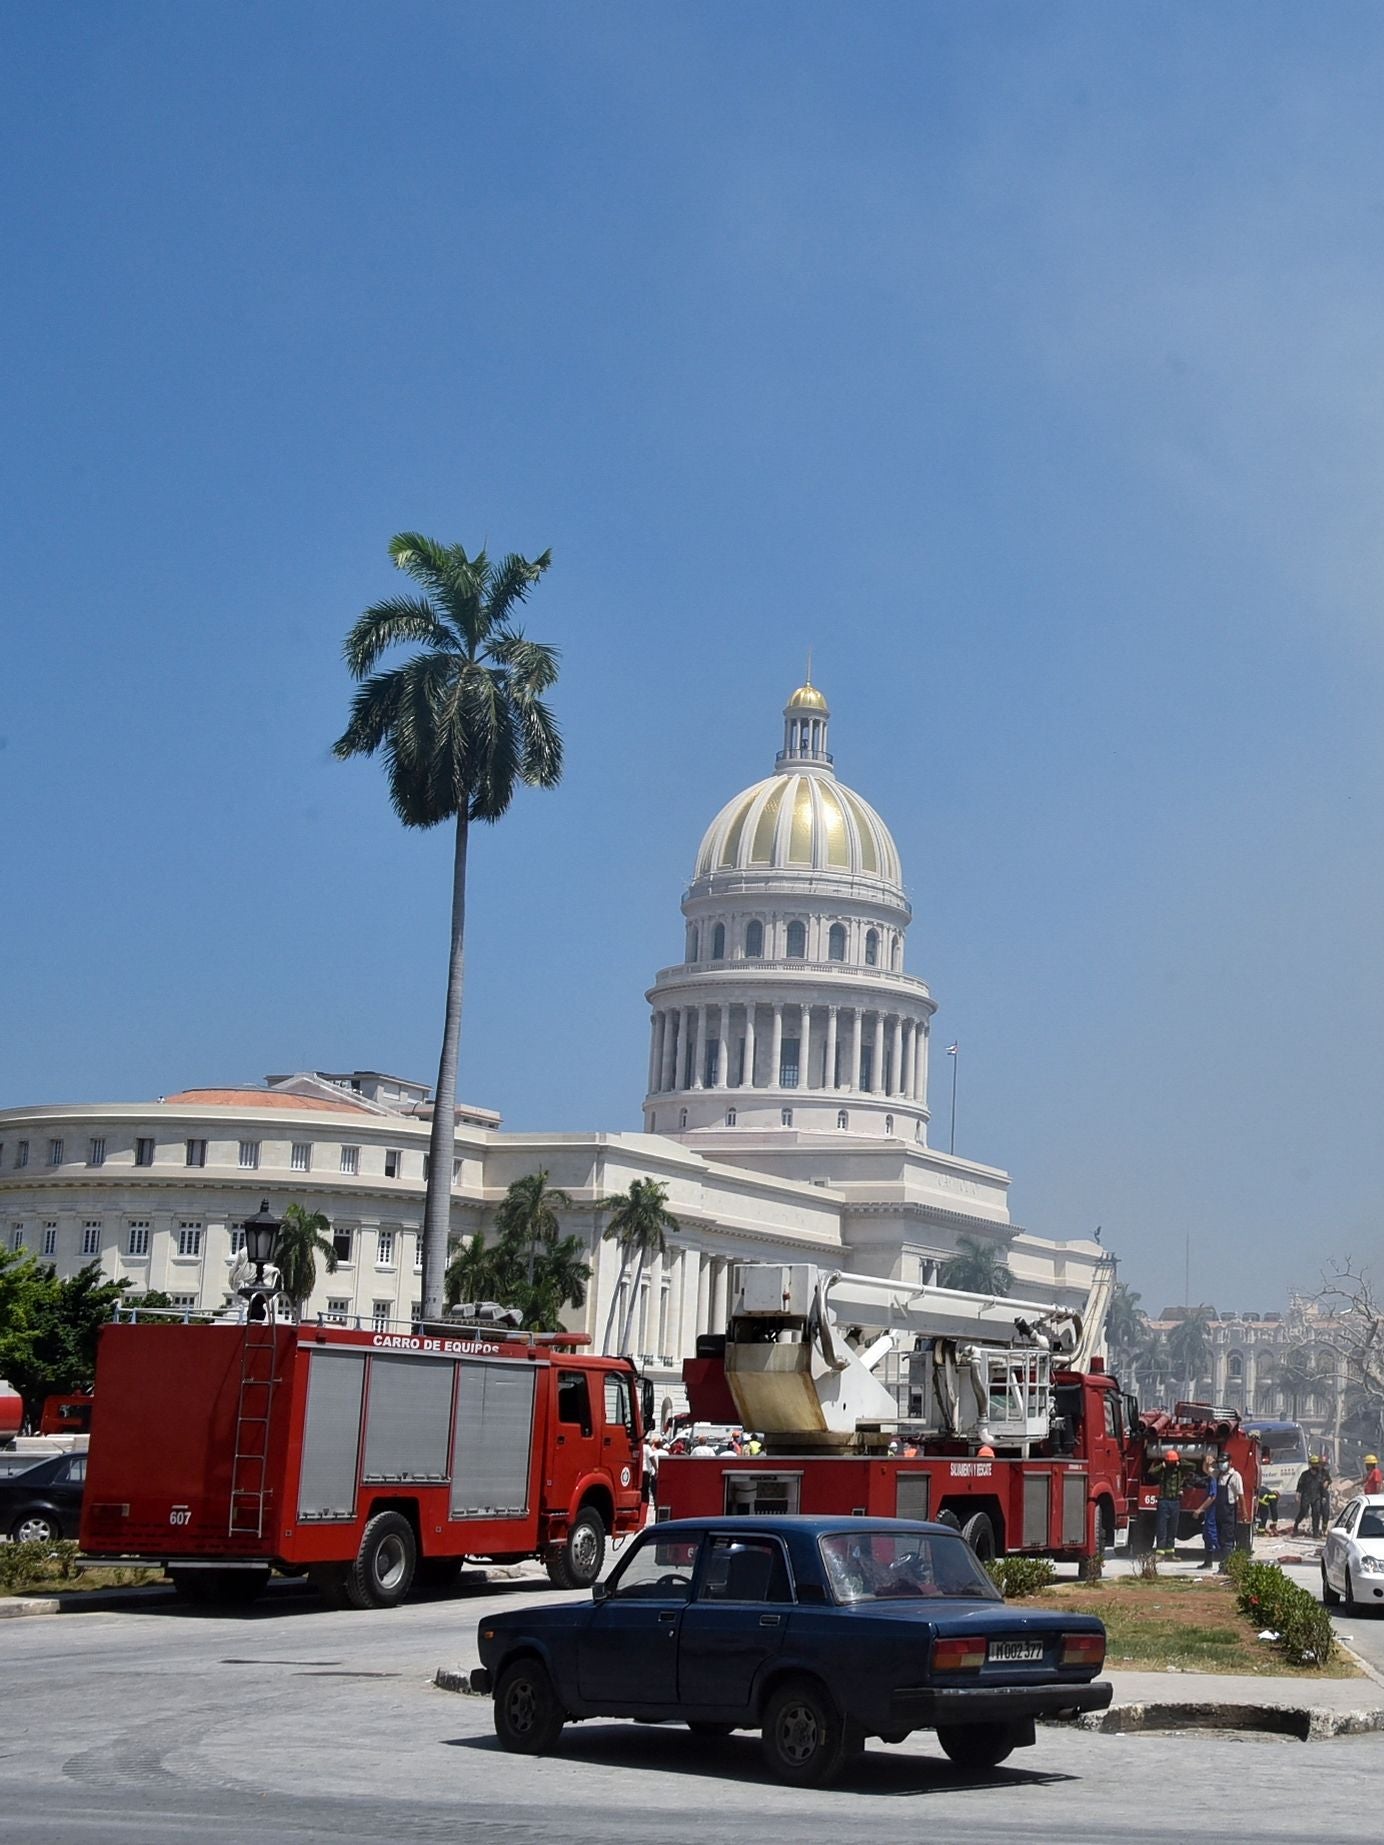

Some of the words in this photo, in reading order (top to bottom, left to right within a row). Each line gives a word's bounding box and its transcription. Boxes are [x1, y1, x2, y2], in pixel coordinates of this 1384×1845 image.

[373, 1335, 420, 1349] CARRO
[424, 1340, 441, 1351] DE
[444, 1341, 500, 1353] EQUIPOS
[1144, 1494, 1158, 1504] 65
[170, 1511, 191, 1525] 607
